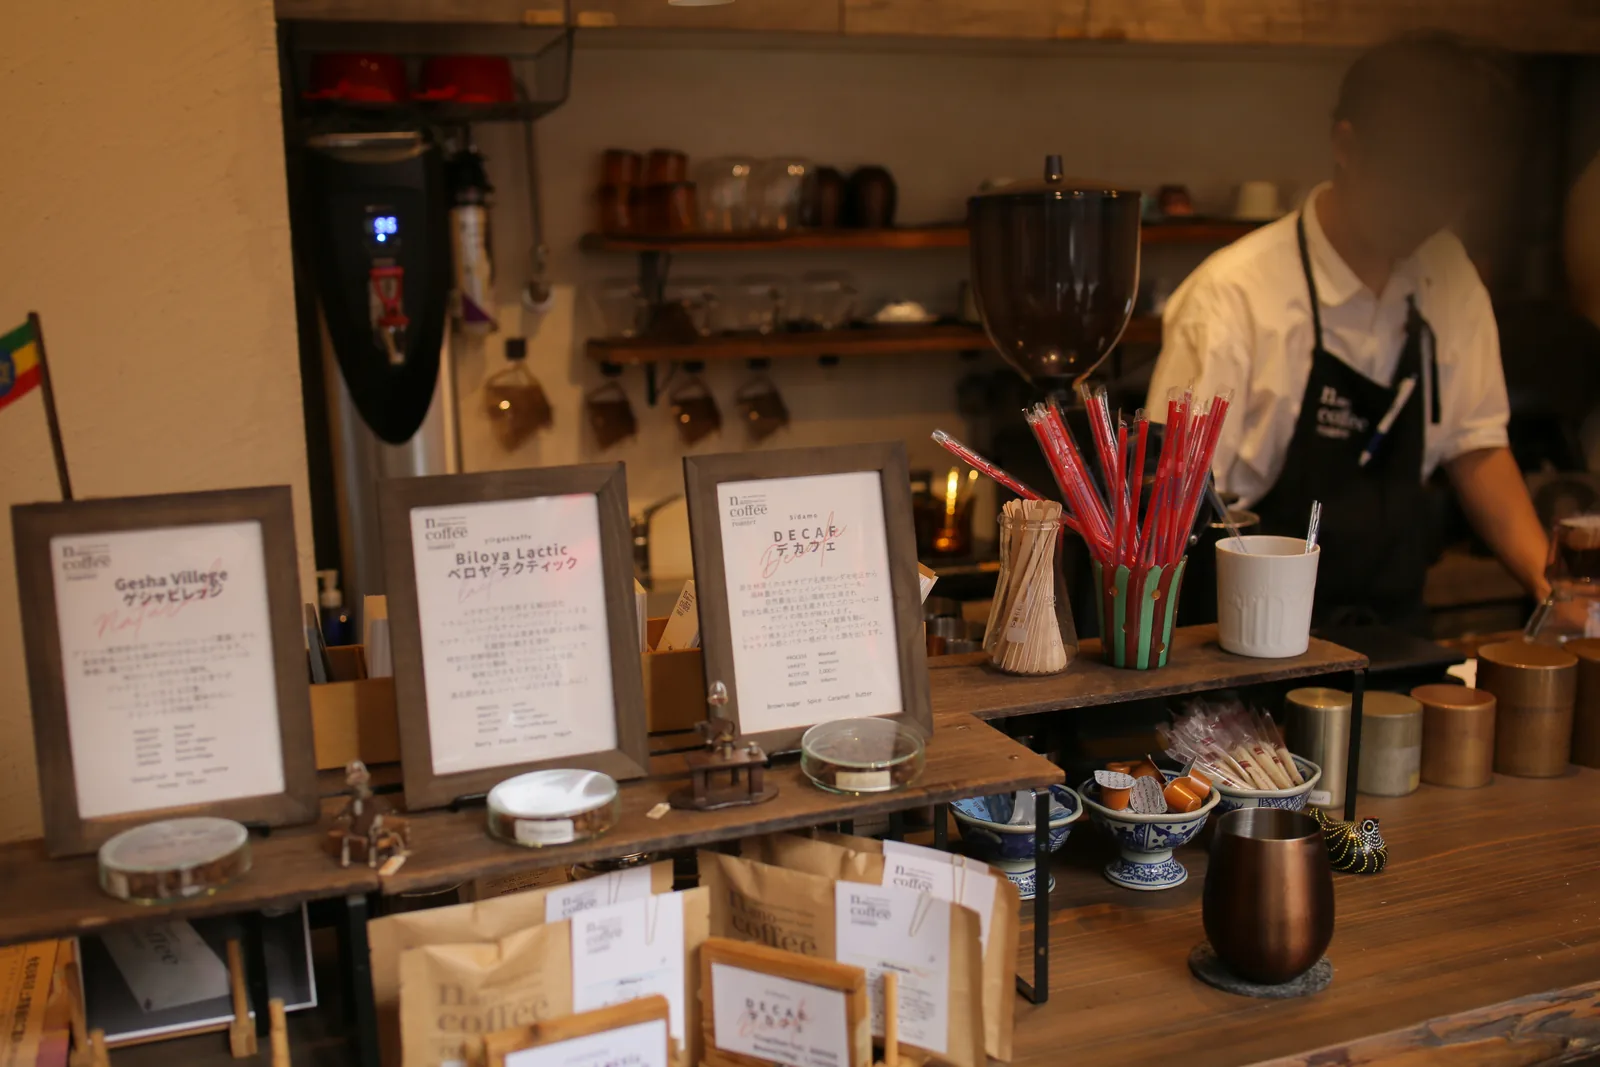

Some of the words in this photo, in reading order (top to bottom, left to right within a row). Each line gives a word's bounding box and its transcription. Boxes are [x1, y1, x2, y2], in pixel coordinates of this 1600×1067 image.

[729, 496, 738, 506] n
[730, 504, 768, 518] coffee
[789, 513, 818, 521] Sidamo
[425, 526, 468, 541] coffee
[773, 525, 836, 543] DECAF
[456, 550, 510, 566] Biloya
[517, 543, 568, 560] Lactic
[776, 542, 836, 556] デカフェ
[499, 556, 578, 577] ラクティック
[115, 574, 168, 591] Gesha
